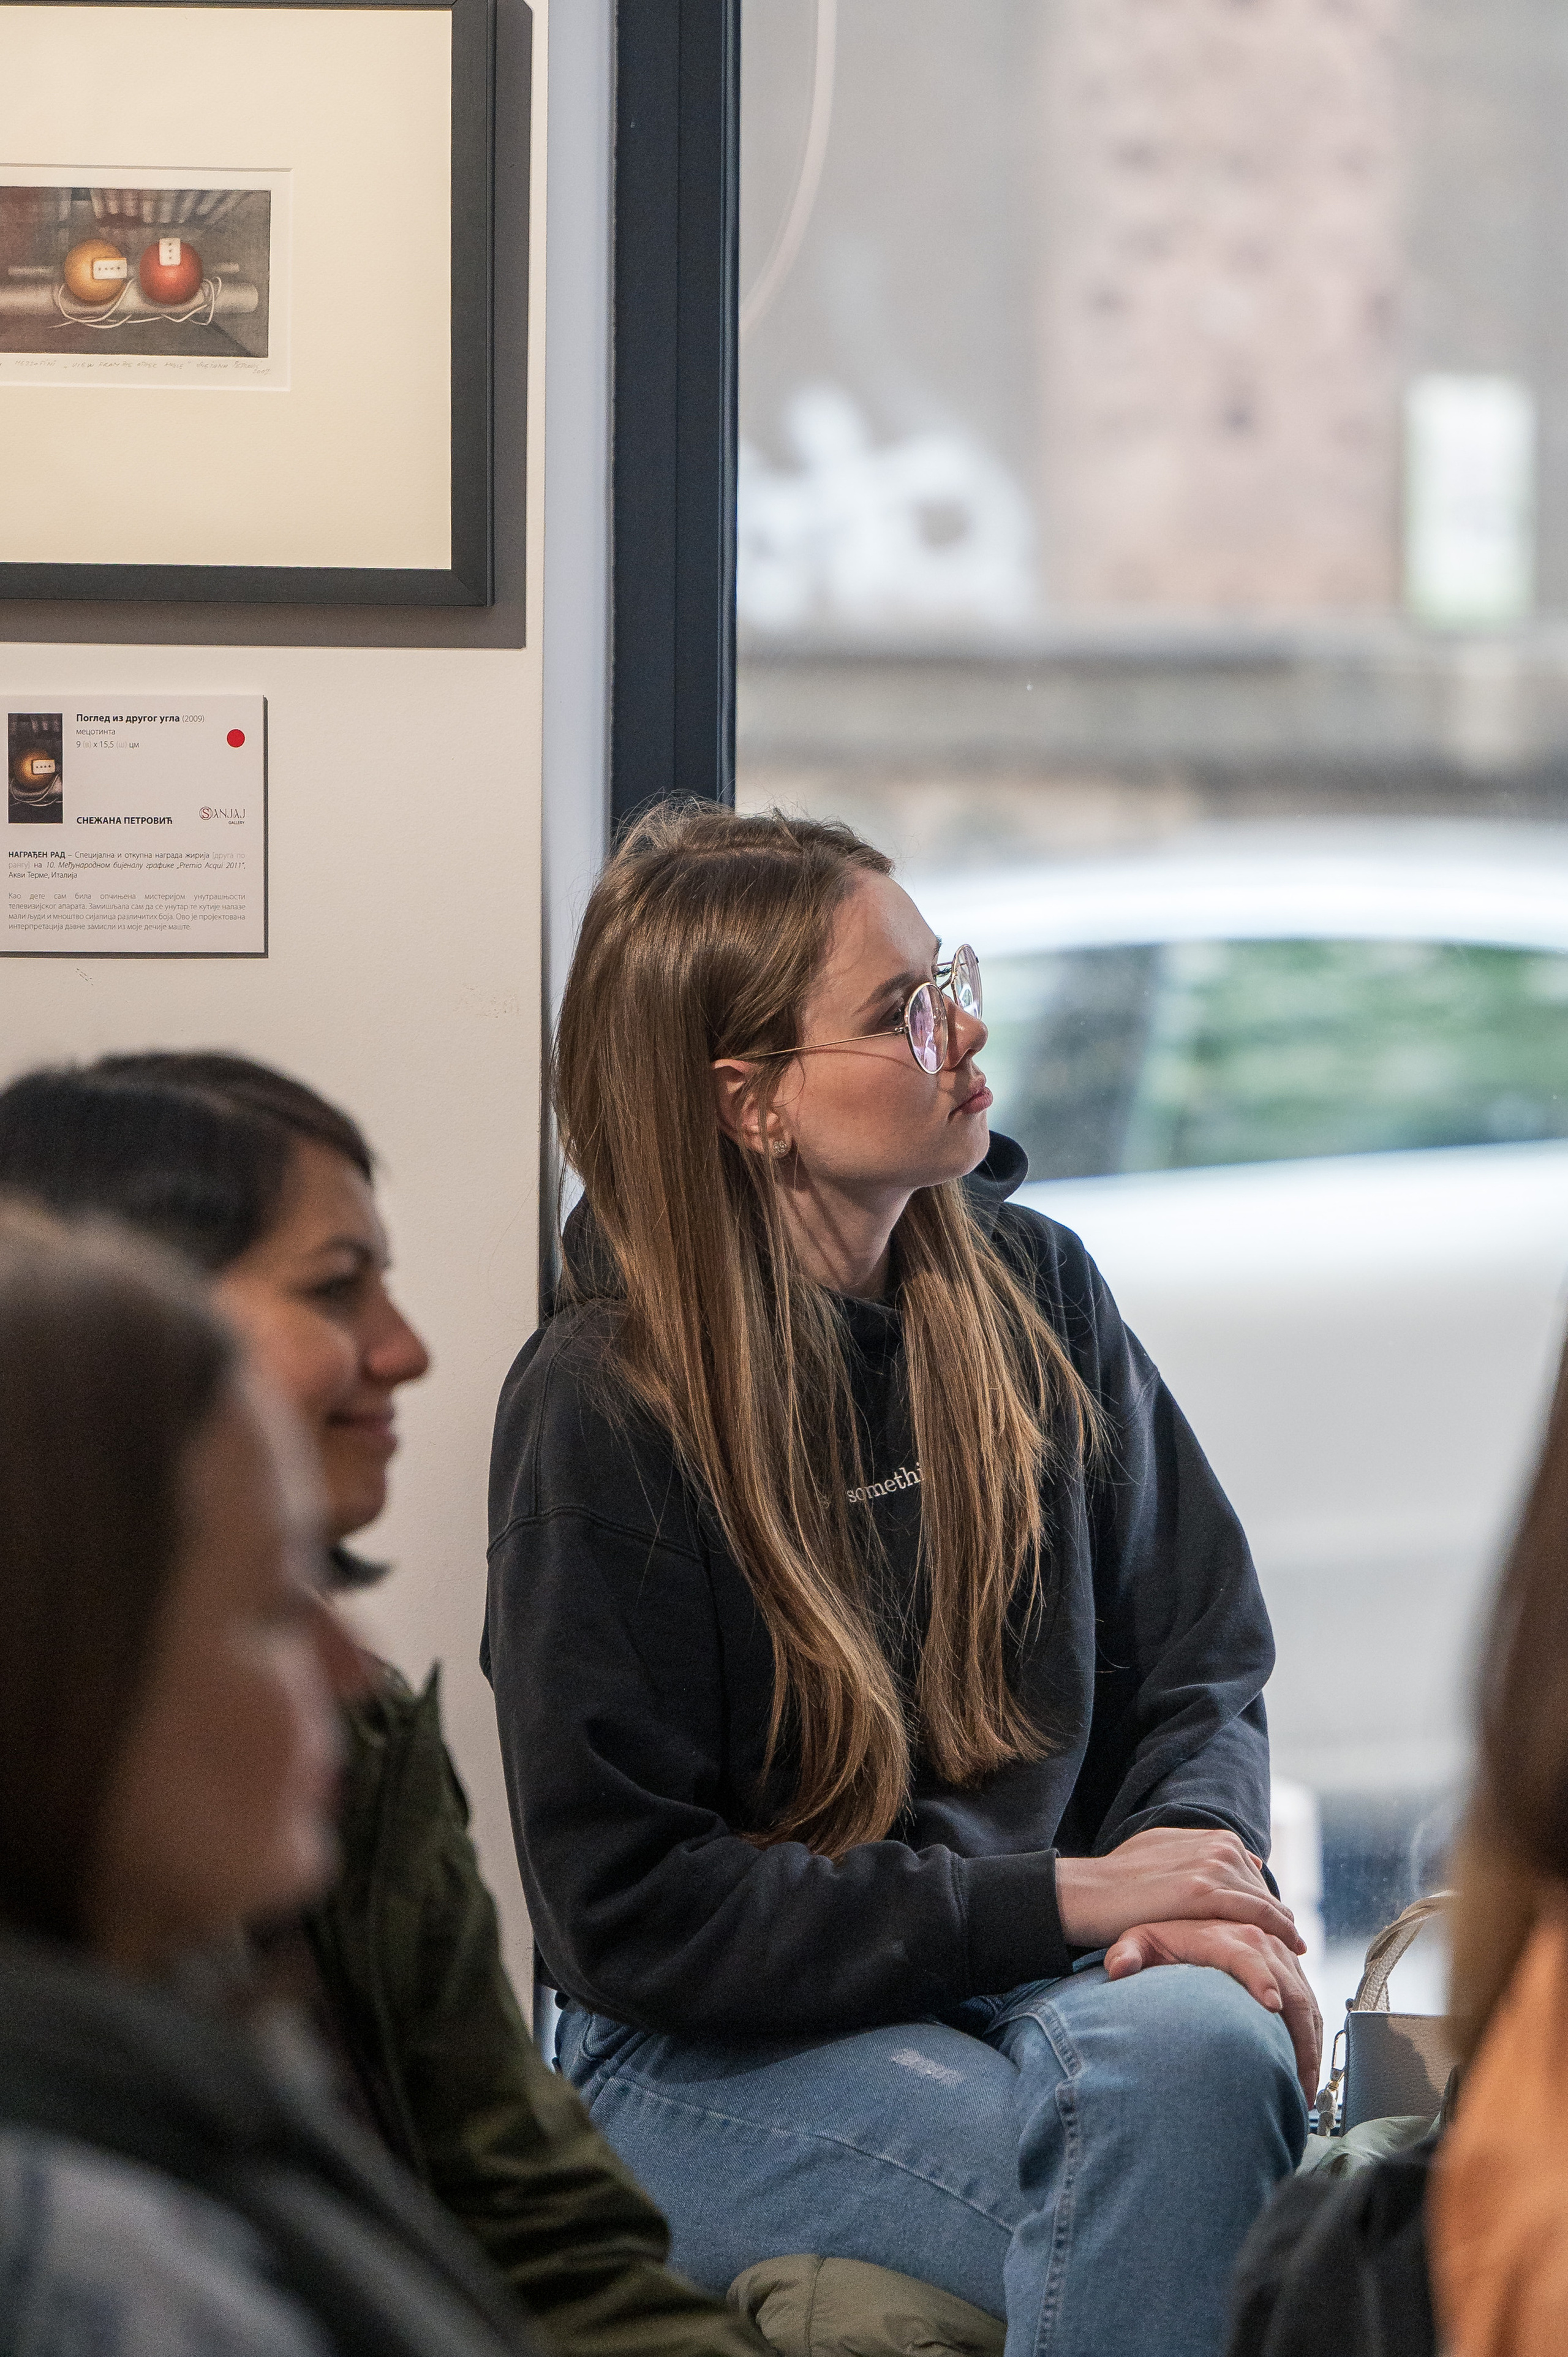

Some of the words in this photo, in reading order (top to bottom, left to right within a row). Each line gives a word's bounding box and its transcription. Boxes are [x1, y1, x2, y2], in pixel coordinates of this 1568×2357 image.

[76, 713, 111, 724] Поглед
[125, 715, 157, 724] другог
[159, 715, 180, 724] угла
[182, 714, 205, 723] (2009)
[191, 913, 197, 921] је
